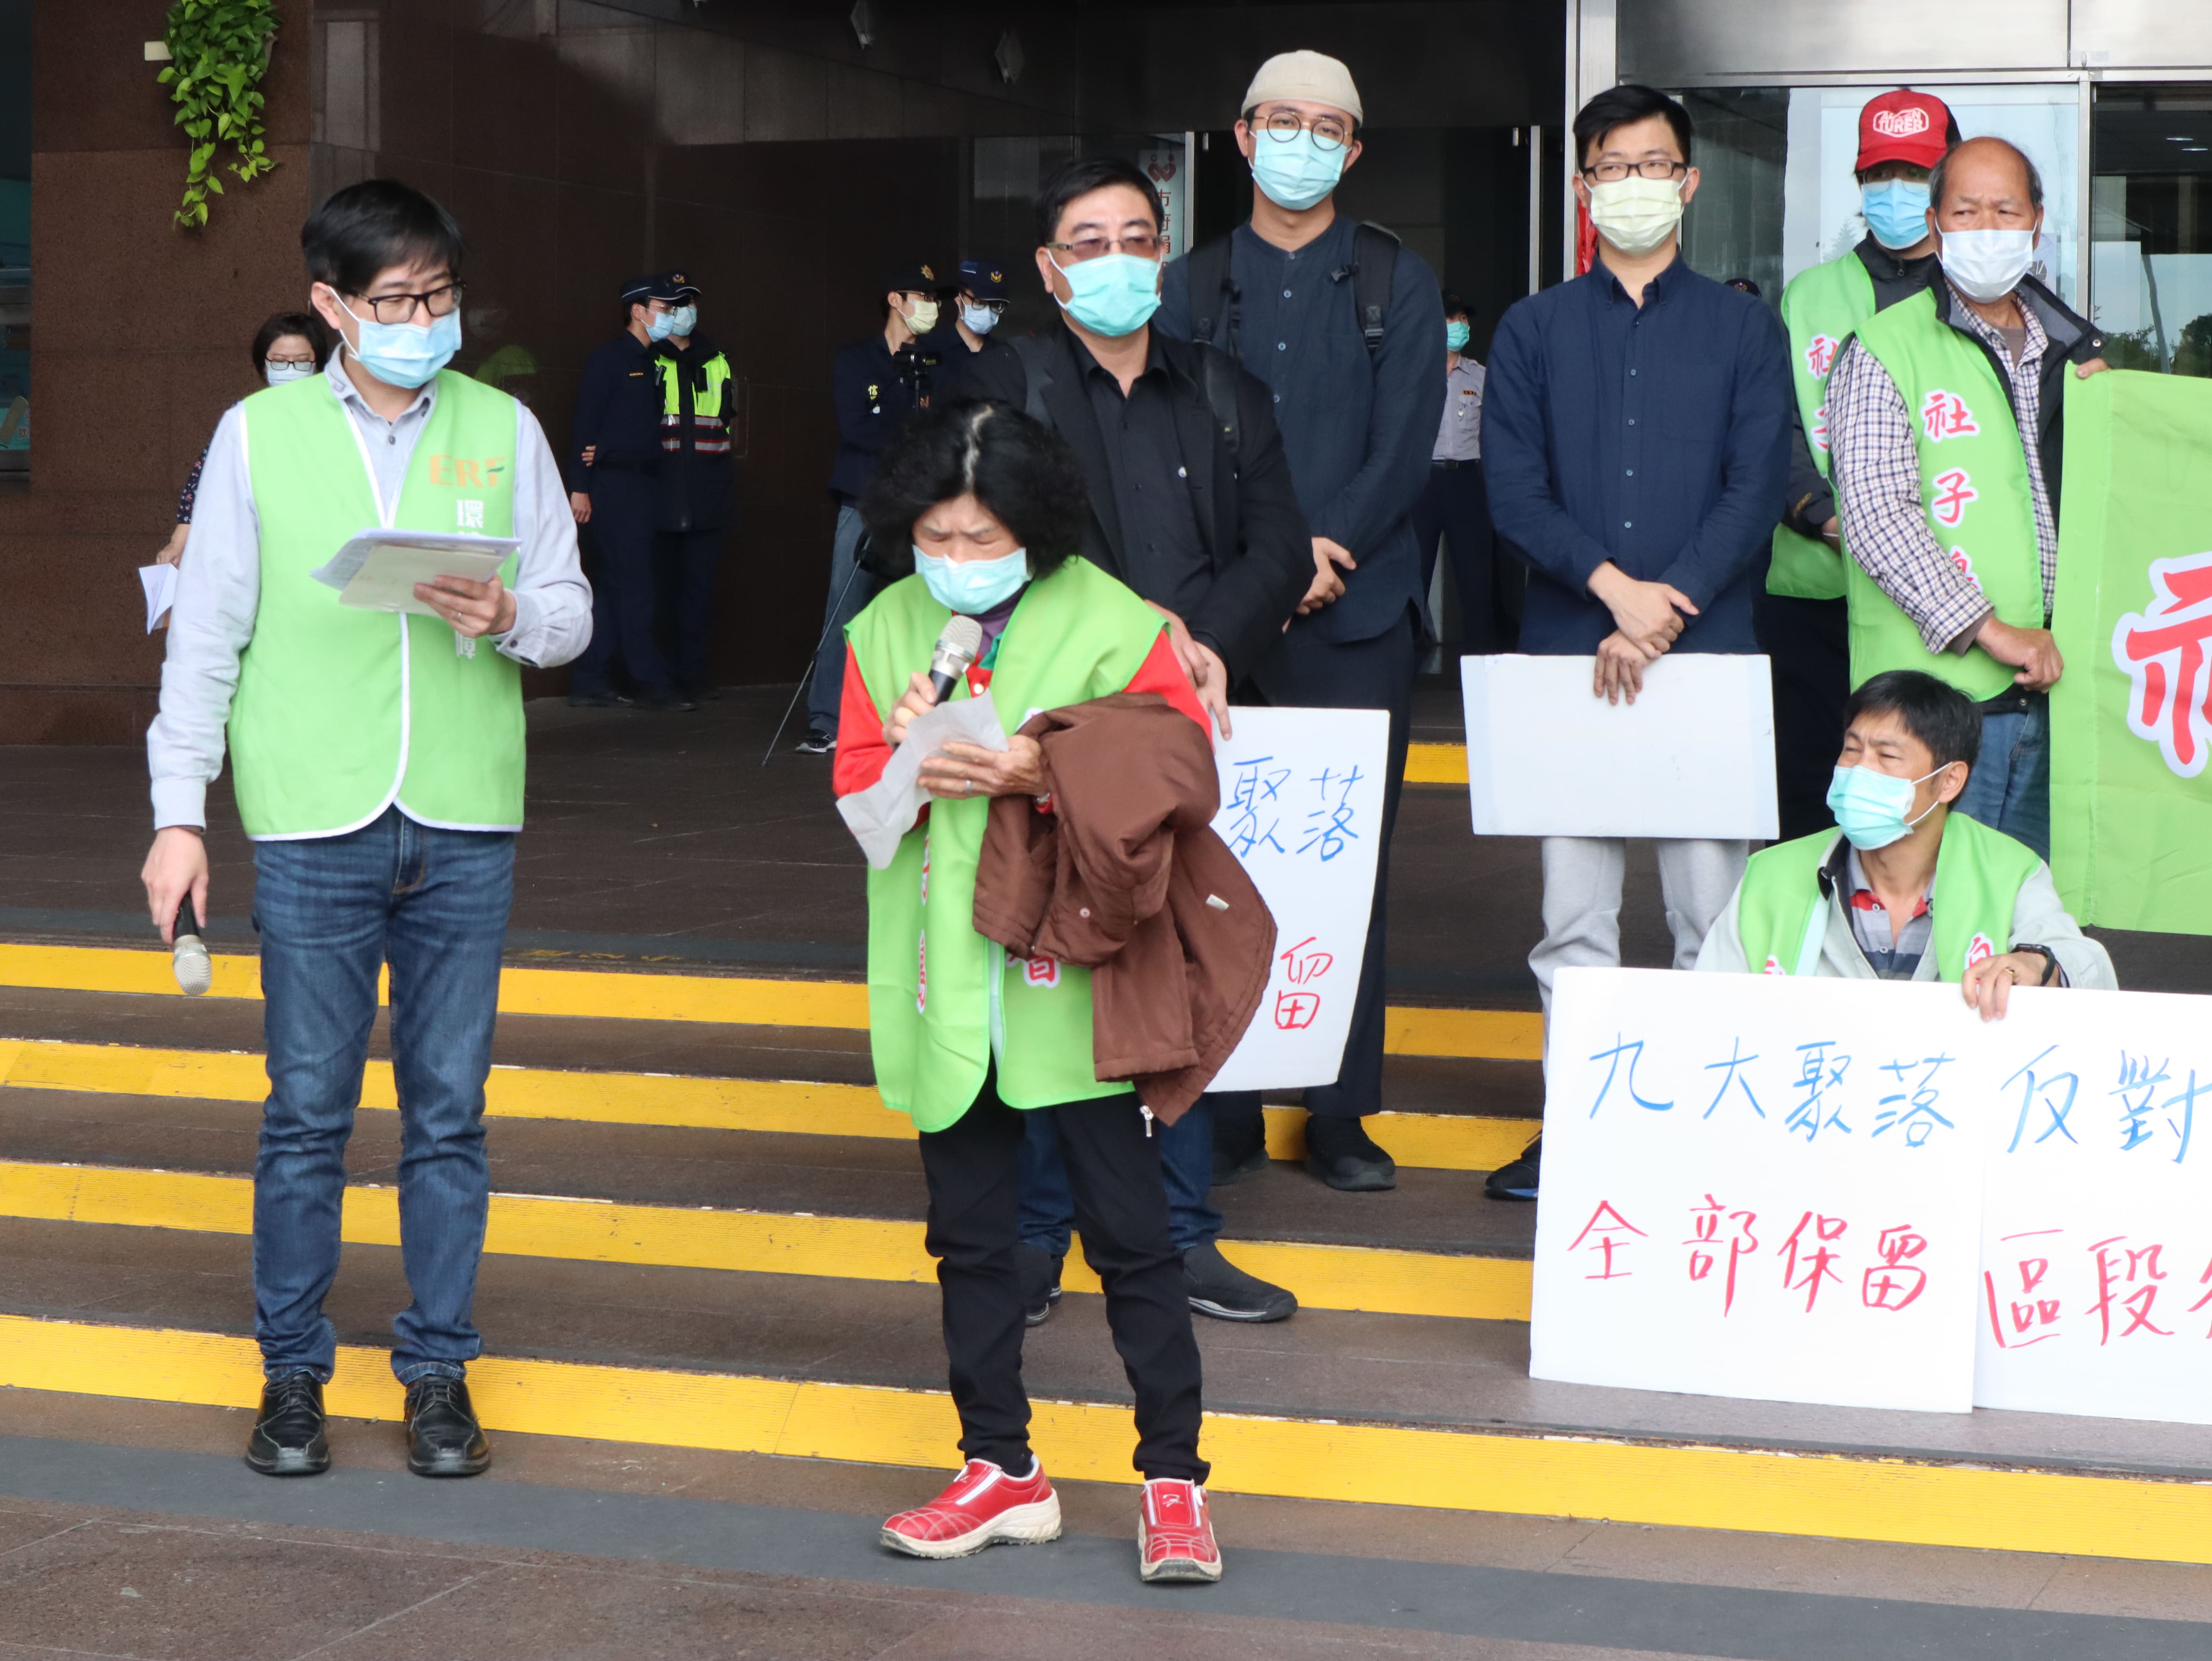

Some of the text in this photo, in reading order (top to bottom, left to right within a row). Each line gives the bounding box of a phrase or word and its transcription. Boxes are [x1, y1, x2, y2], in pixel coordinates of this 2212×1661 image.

[1878, 118, 1923, 132] TURER
[429, 454, 505, 488] ERF
[1226, 755, 1365, 863] 聚落
[1274, 936, 1334, 1031] 留
[1588, 1032, 1956, 1149] 九大聚落
[2000, 1044, 2212, 1164] 反對
[1567, 1193, 1928, 1318] 全部保留
